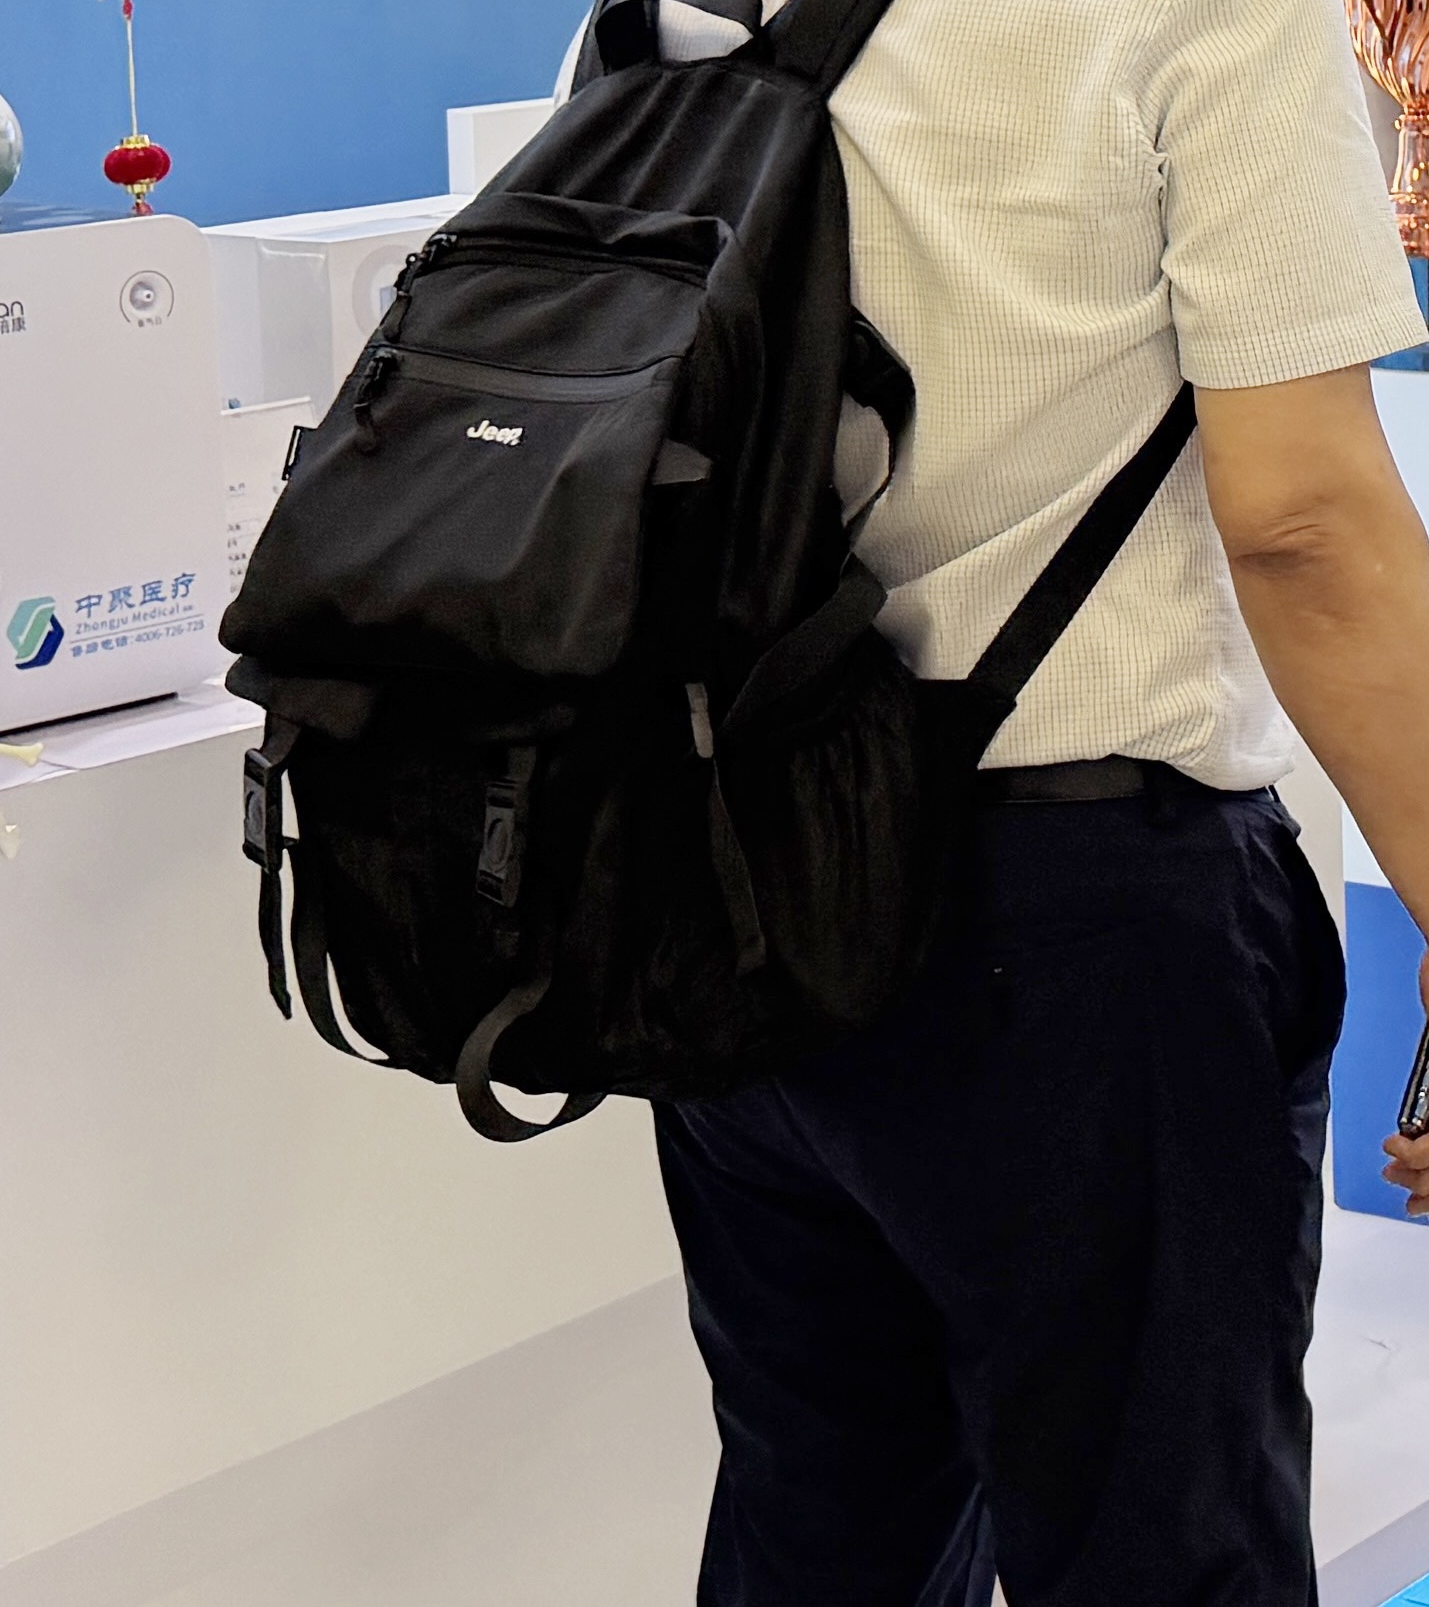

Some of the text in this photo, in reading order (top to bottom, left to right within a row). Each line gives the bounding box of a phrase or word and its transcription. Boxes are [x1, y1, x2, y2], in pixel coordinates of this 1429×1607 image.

[466, 419, 523, 446] Jeep
[75, 572, 196, 620] 中聚医疗
[132, 602, 180, 623] Medical
